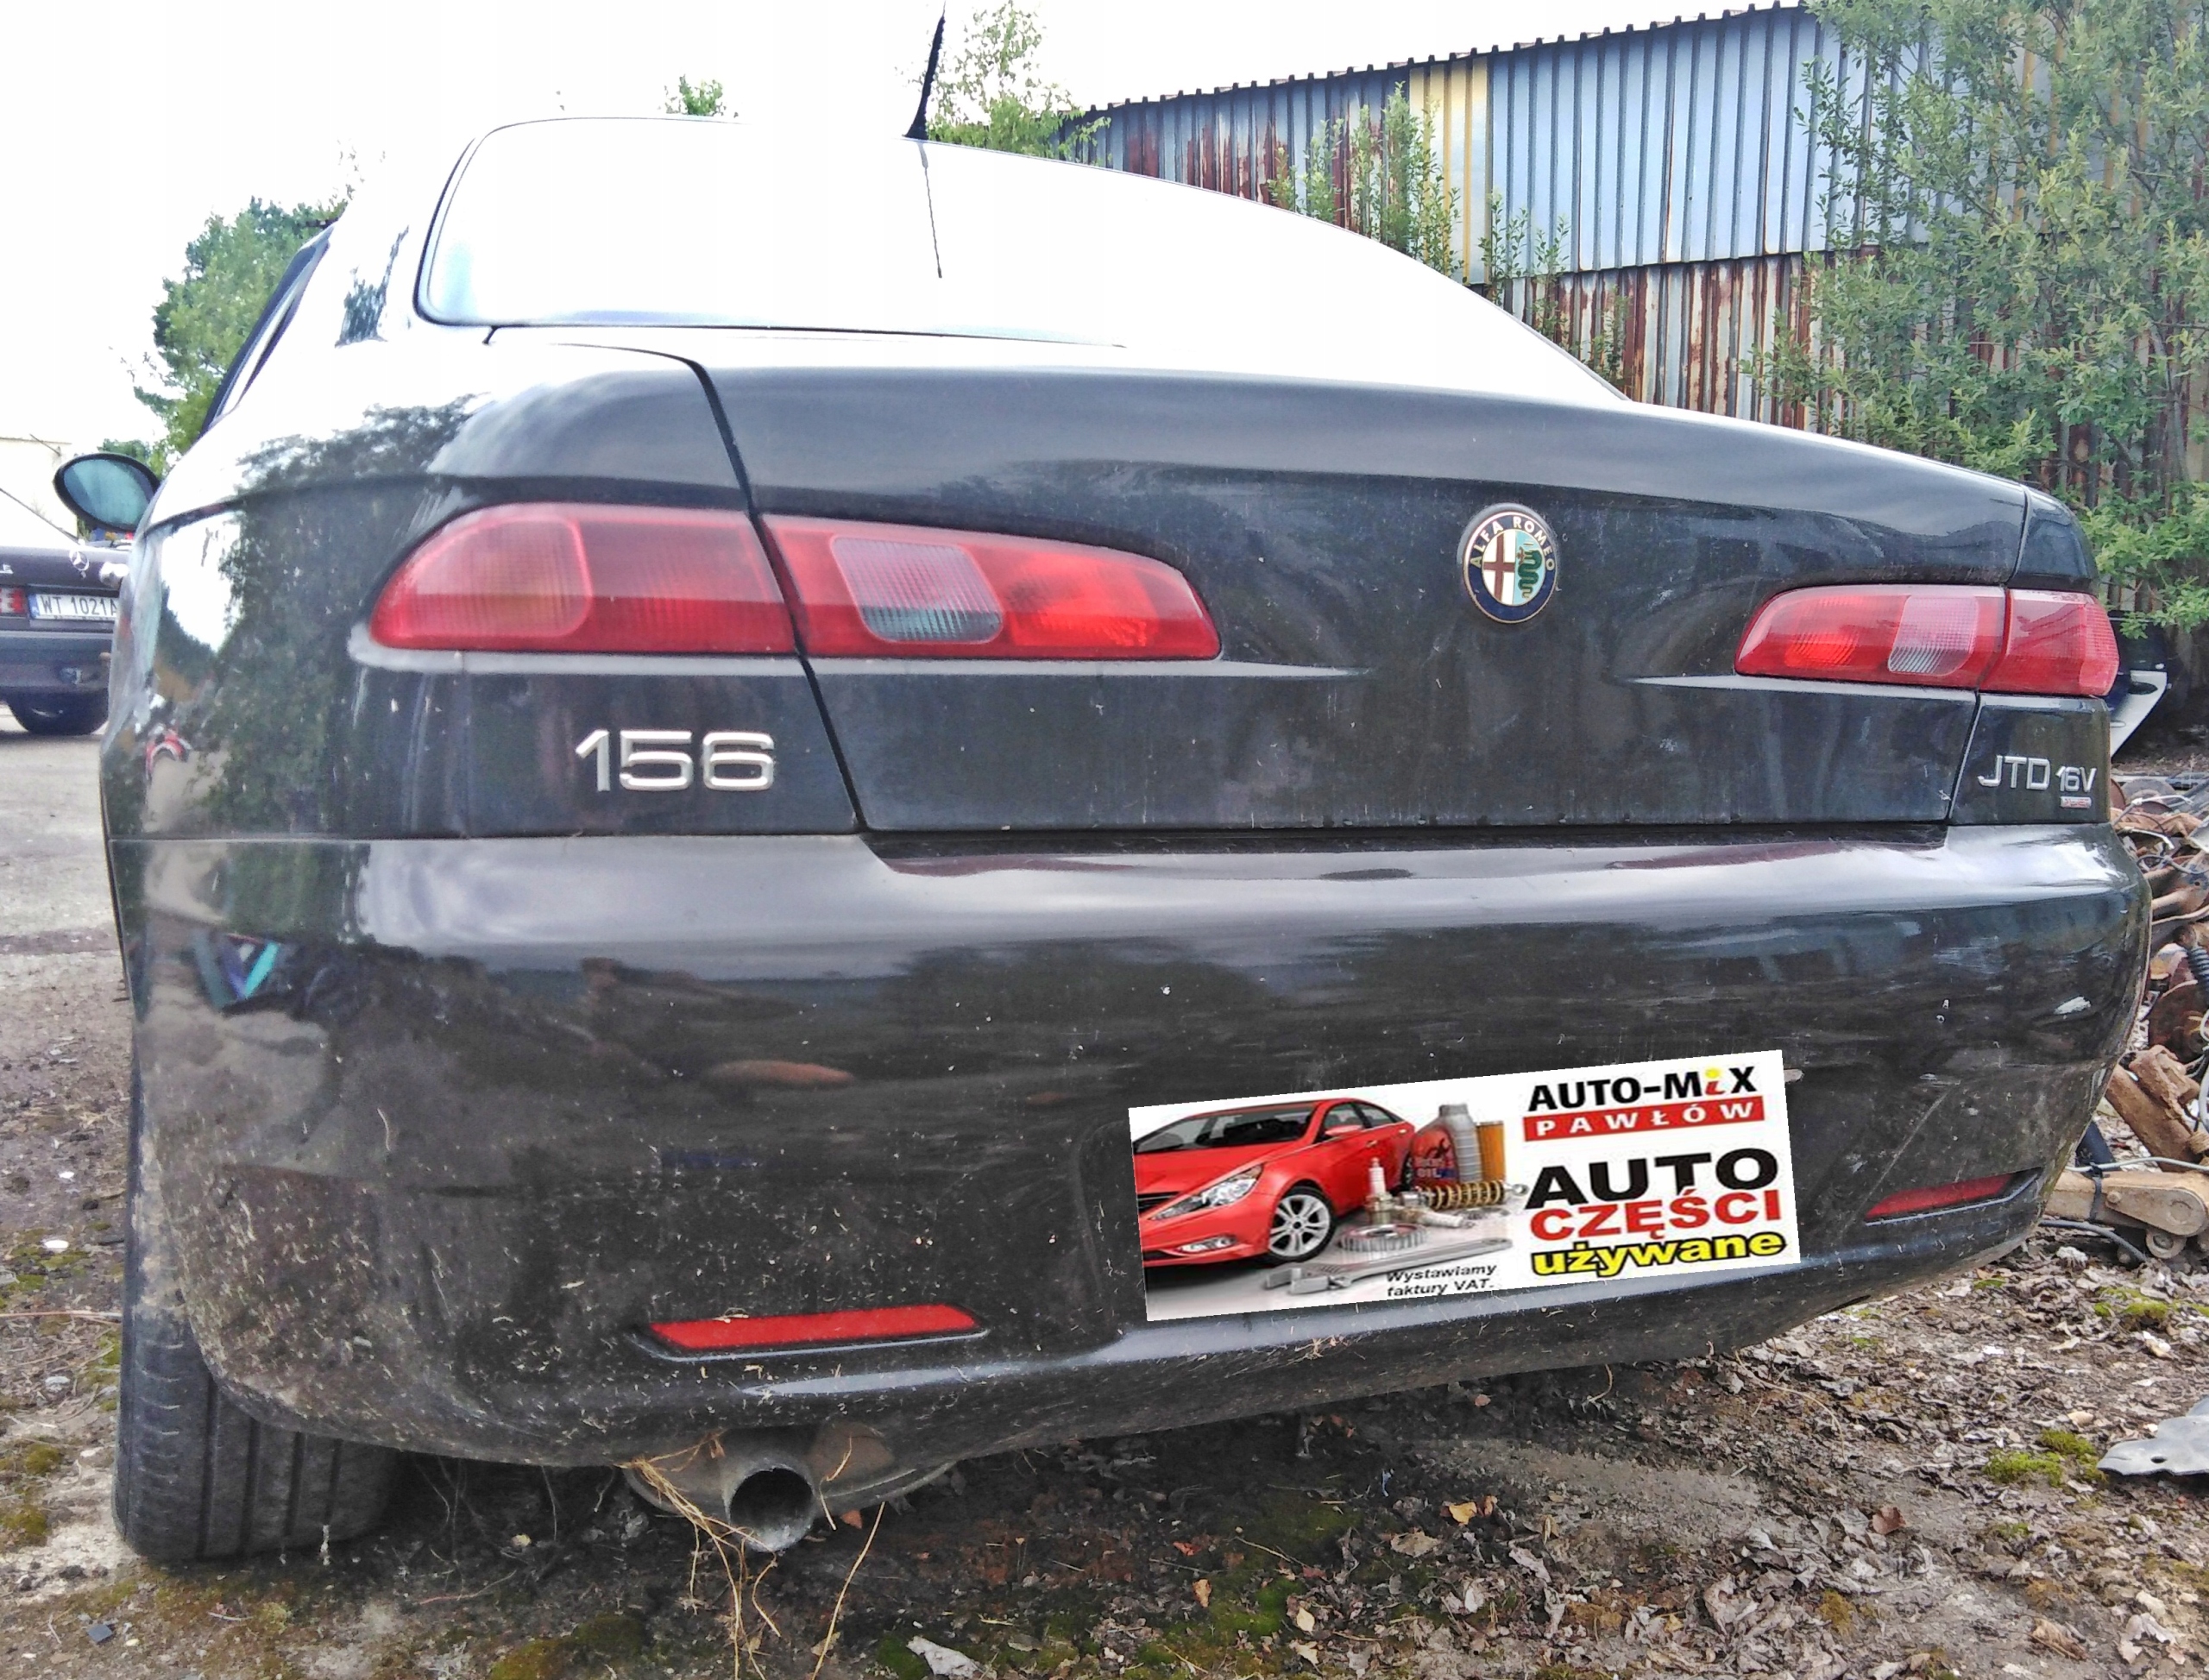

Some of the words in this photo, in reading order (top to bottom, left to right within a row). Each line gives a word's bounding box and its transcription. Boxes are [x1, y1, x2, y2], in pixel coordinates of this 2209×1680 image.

[1470, 521, 1504, 569] ALFA
[1513, 516, 1555, 571] ROMEO
[40, 595, 61, 614] WT
[575, 729, 775, 792] 156
[1977, 754, 2051, 790] JTD
[2055, 765, 2098, 793] 16V
